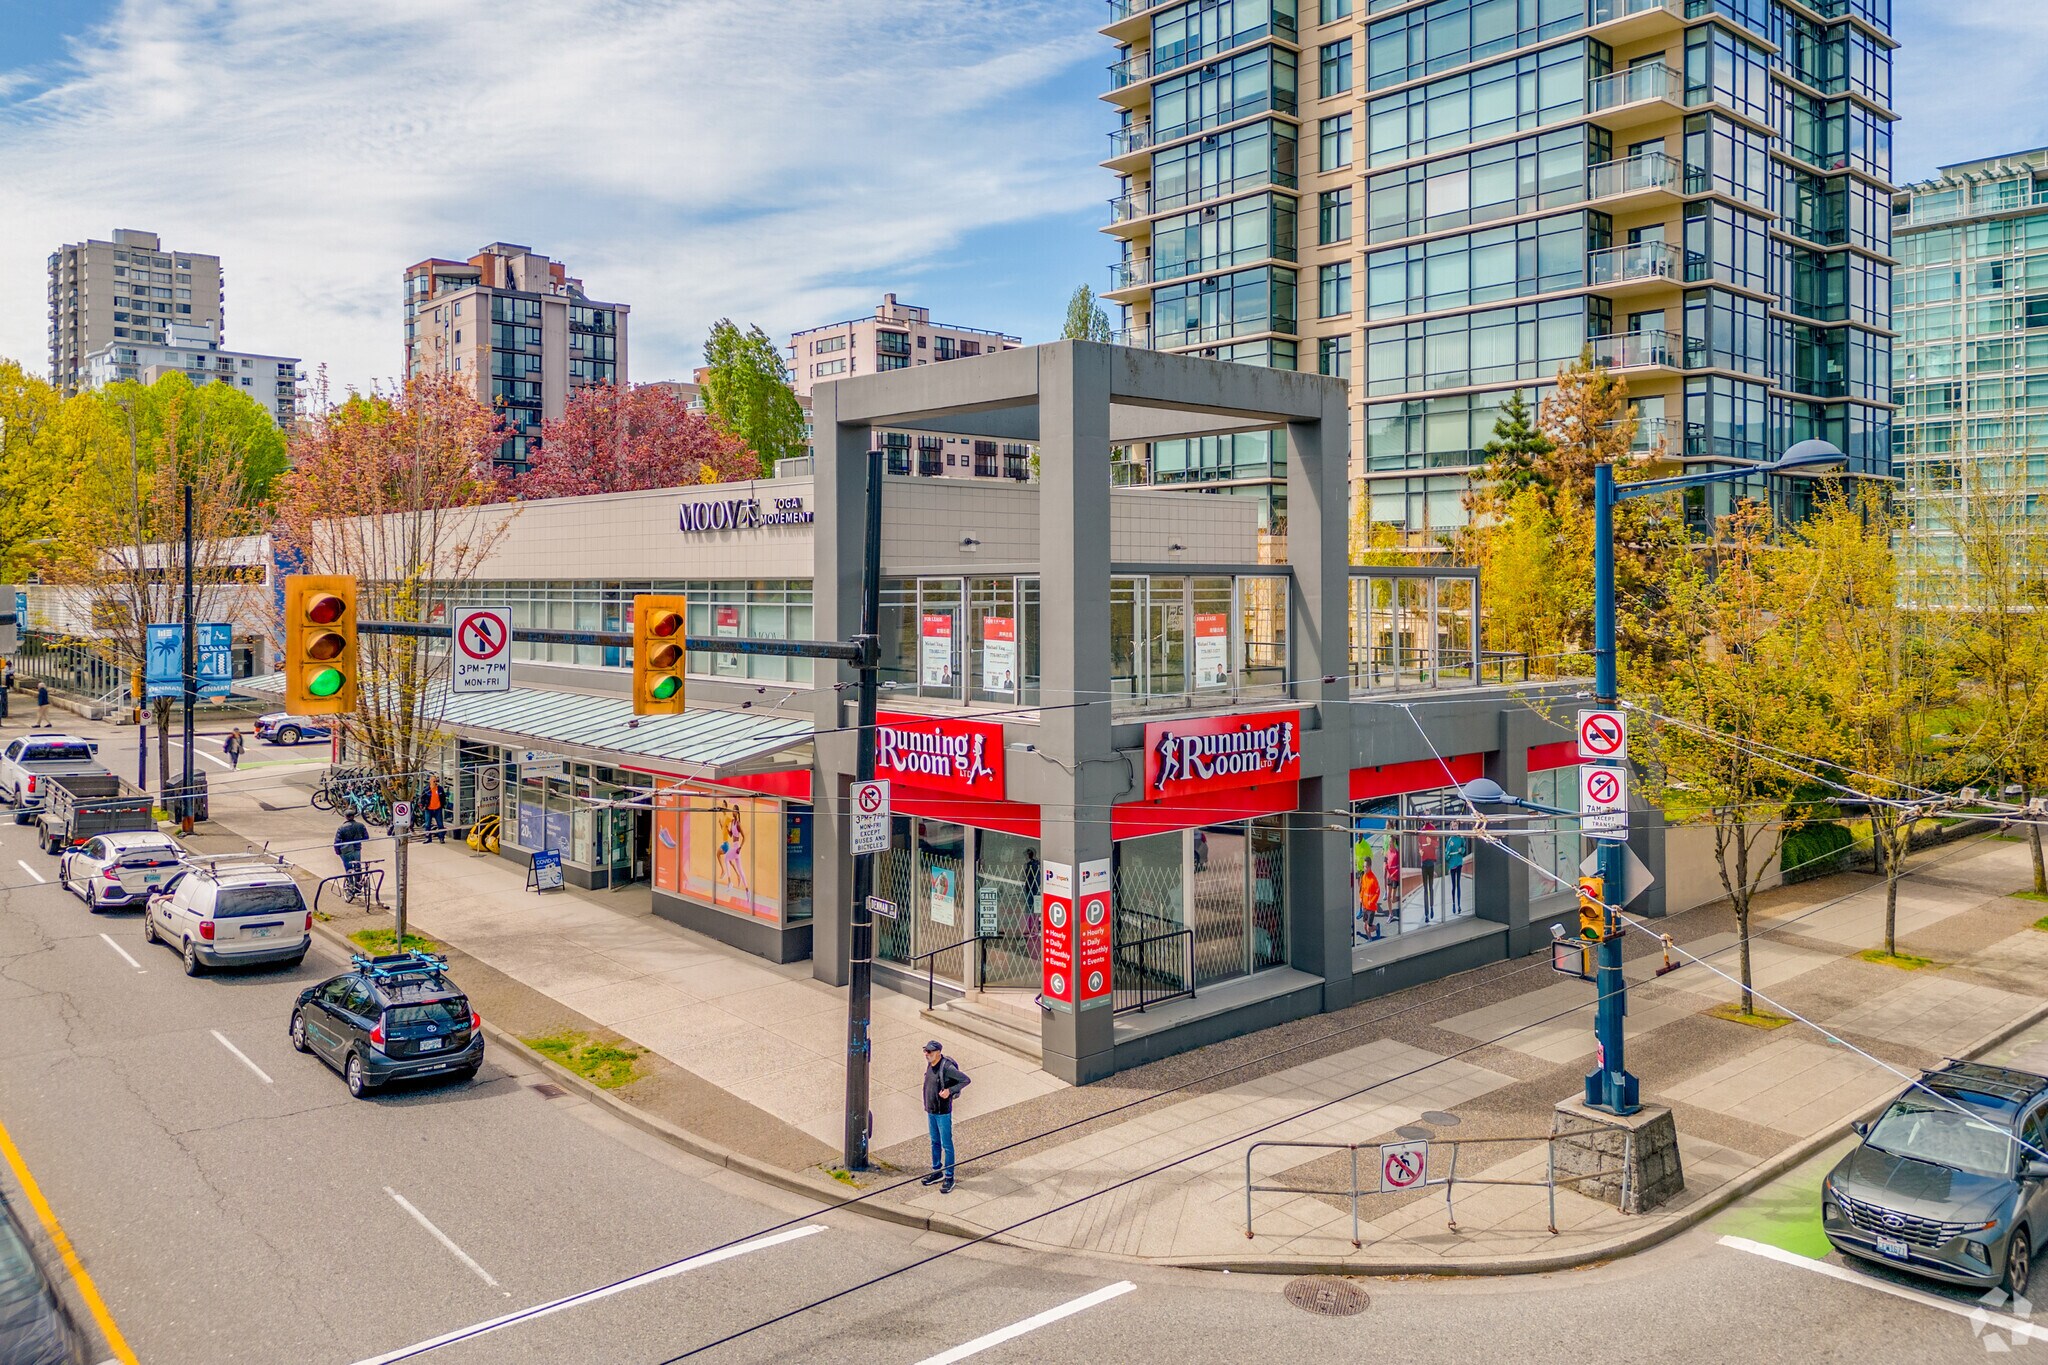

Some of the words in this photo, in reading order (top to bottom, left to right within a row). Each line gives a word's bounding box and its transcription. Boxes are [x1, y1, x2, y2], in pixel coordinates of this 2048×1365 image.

[774, 498, 803, 509] YOGA
[760, 512, 814, 525] MOVEMENT
[464, 678, 500, 687] MON-FRI
[149, 685, 182, 693] DENMAN
[1180, 723, 1280, 762] Running
[878, 727, 969, 770] Running
[860, 822, 881, 830] MON-FRI
[860, 829, 880, 837] EXCEPT
[855, 837, 873, 845] BUSES
[858, 842, 883, 851] BICYCLES
[536, 857, 559, 866] COVID-19
[981, 892, 996, 900] SALE
[1050, 929, 1066, 941] Hourly
[1086, 927, 1105, 938] Hourly
[1050, 938, 1063, 949] Daily
[1086, 937, 1101, 946] Daily
[1050, 948, 1071, 961] Monthly
[1087, 945, 1109, 956] Monthly
[1050, 957, 1067, 969] Events
[1087, 956, 1105, 966] Events
